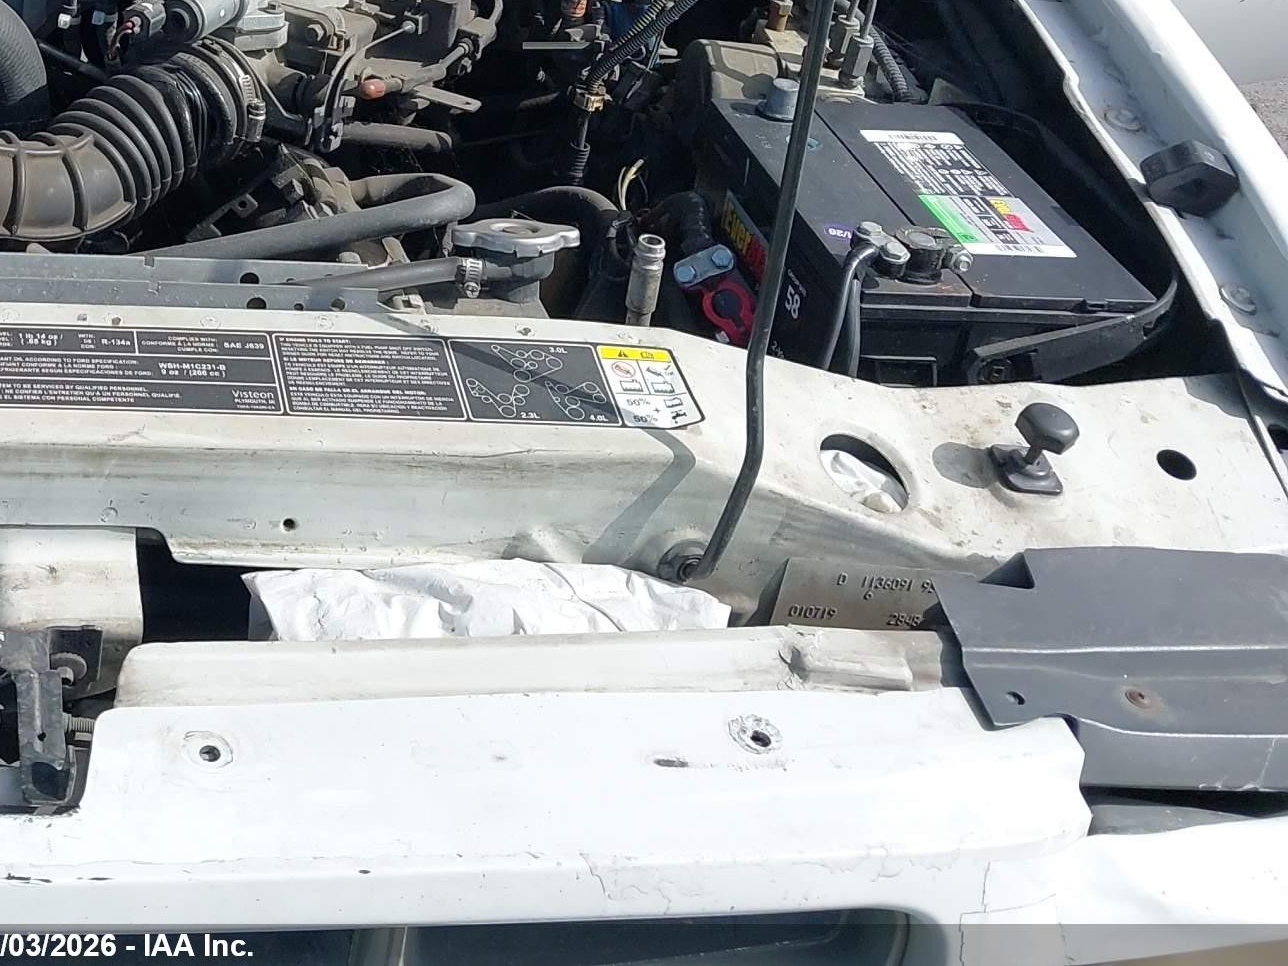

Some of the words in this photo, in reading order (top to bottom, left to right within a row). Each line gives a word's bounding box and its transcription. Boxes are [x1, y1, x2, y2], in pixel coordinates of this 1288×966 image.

[785, 285, 801, 319] 58
[232, 389, 274, 399] Visteon
[626, 398, 650, 406] 50%
[633, 414, 659, 423] 50%
[837, 572, 848, 586] D
[860, 575, 912, 592] 1136091
[863, 590, 874, 600] 6
[787, 604, 838, 620] 010719
